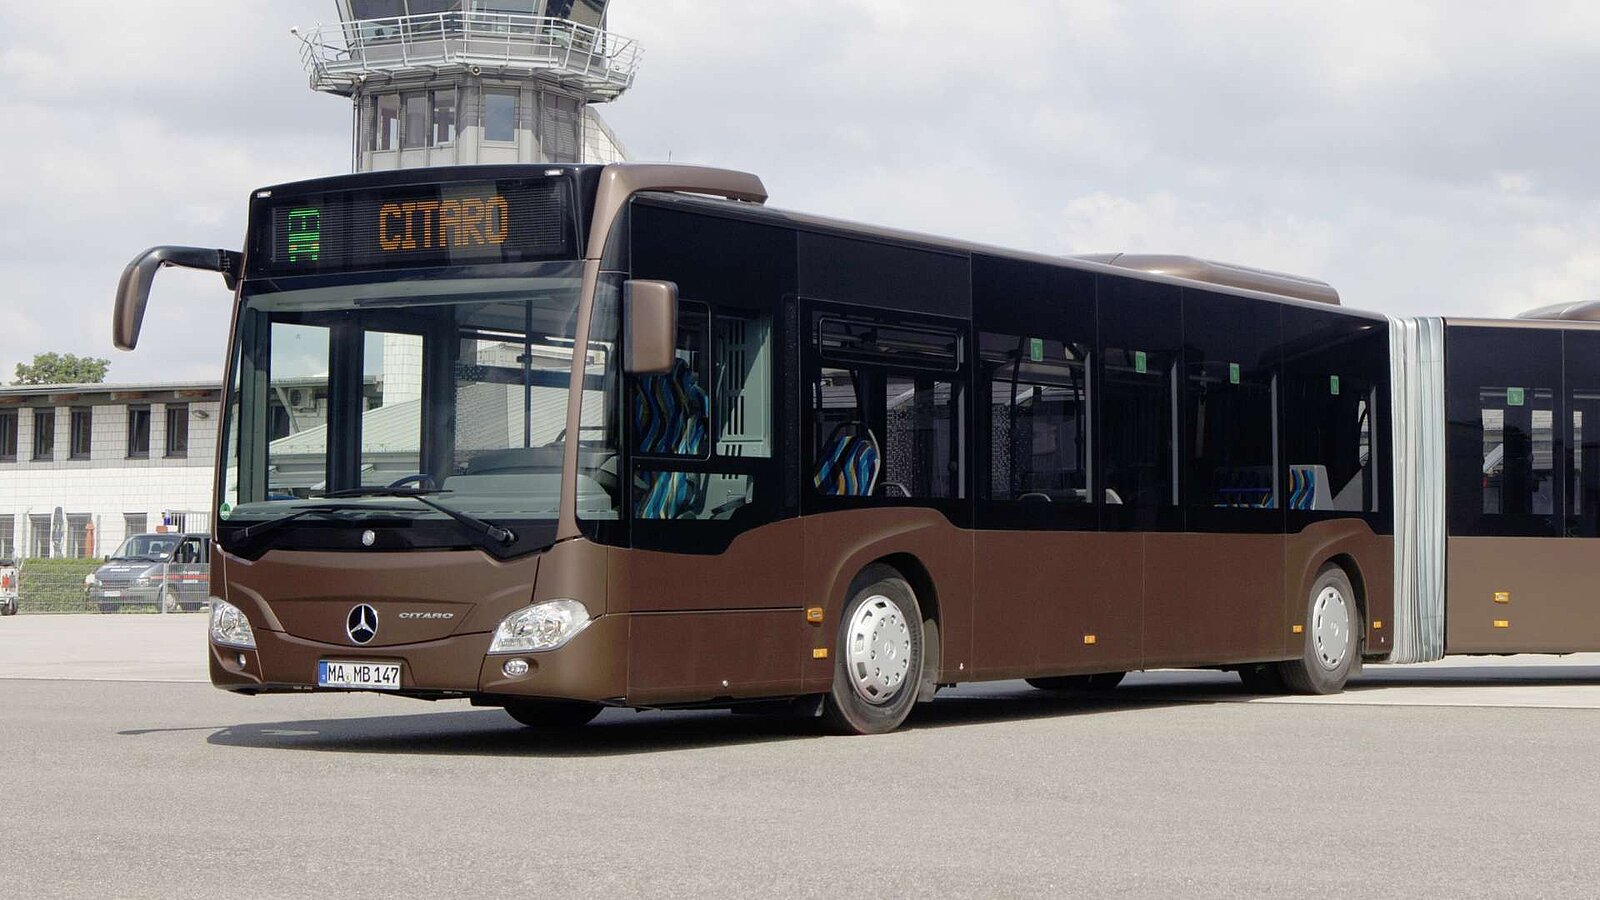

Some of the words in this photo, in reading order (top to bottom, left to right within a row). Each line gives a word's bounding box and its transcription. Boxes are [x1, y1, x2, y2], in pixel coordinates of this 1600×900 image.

[379, 196, 508, 250] CITARO
[328, 665, 345, 682] MA
[353, 666, 371, 683] MB
[374, 667, 399, 684] 147
